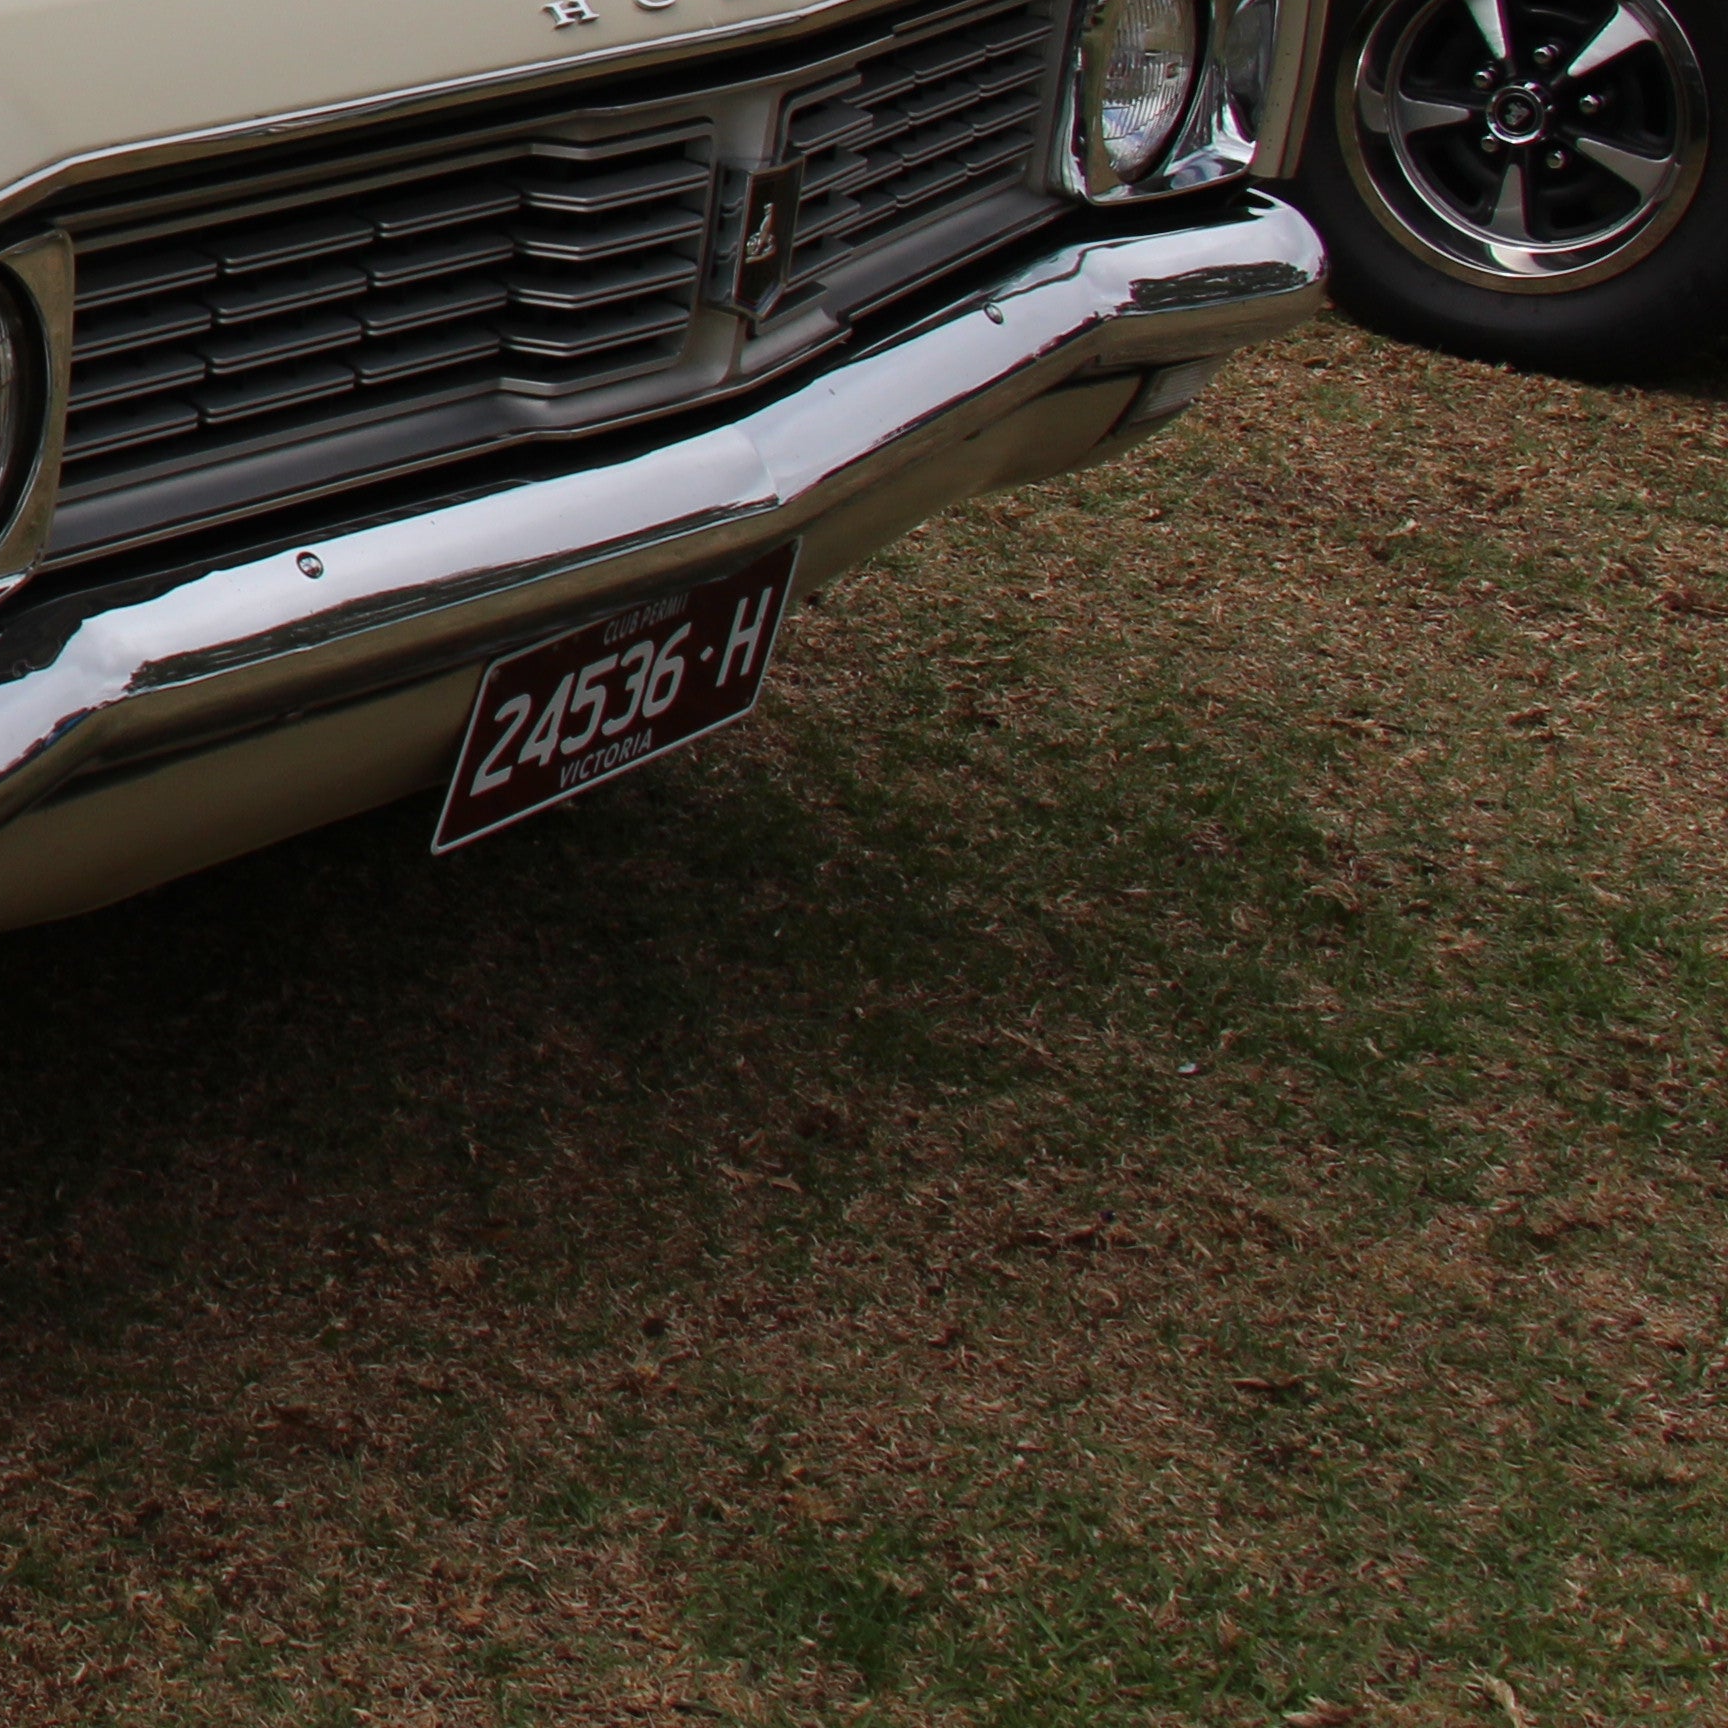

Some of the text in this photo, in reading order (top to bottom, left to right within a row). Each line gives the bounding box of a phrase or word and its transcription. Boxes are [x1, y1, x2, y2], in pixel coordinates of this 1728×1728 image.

[603, 591, 690, 647] CLUB PERMIT
[560, 728, 652, 788] VICTORIA
